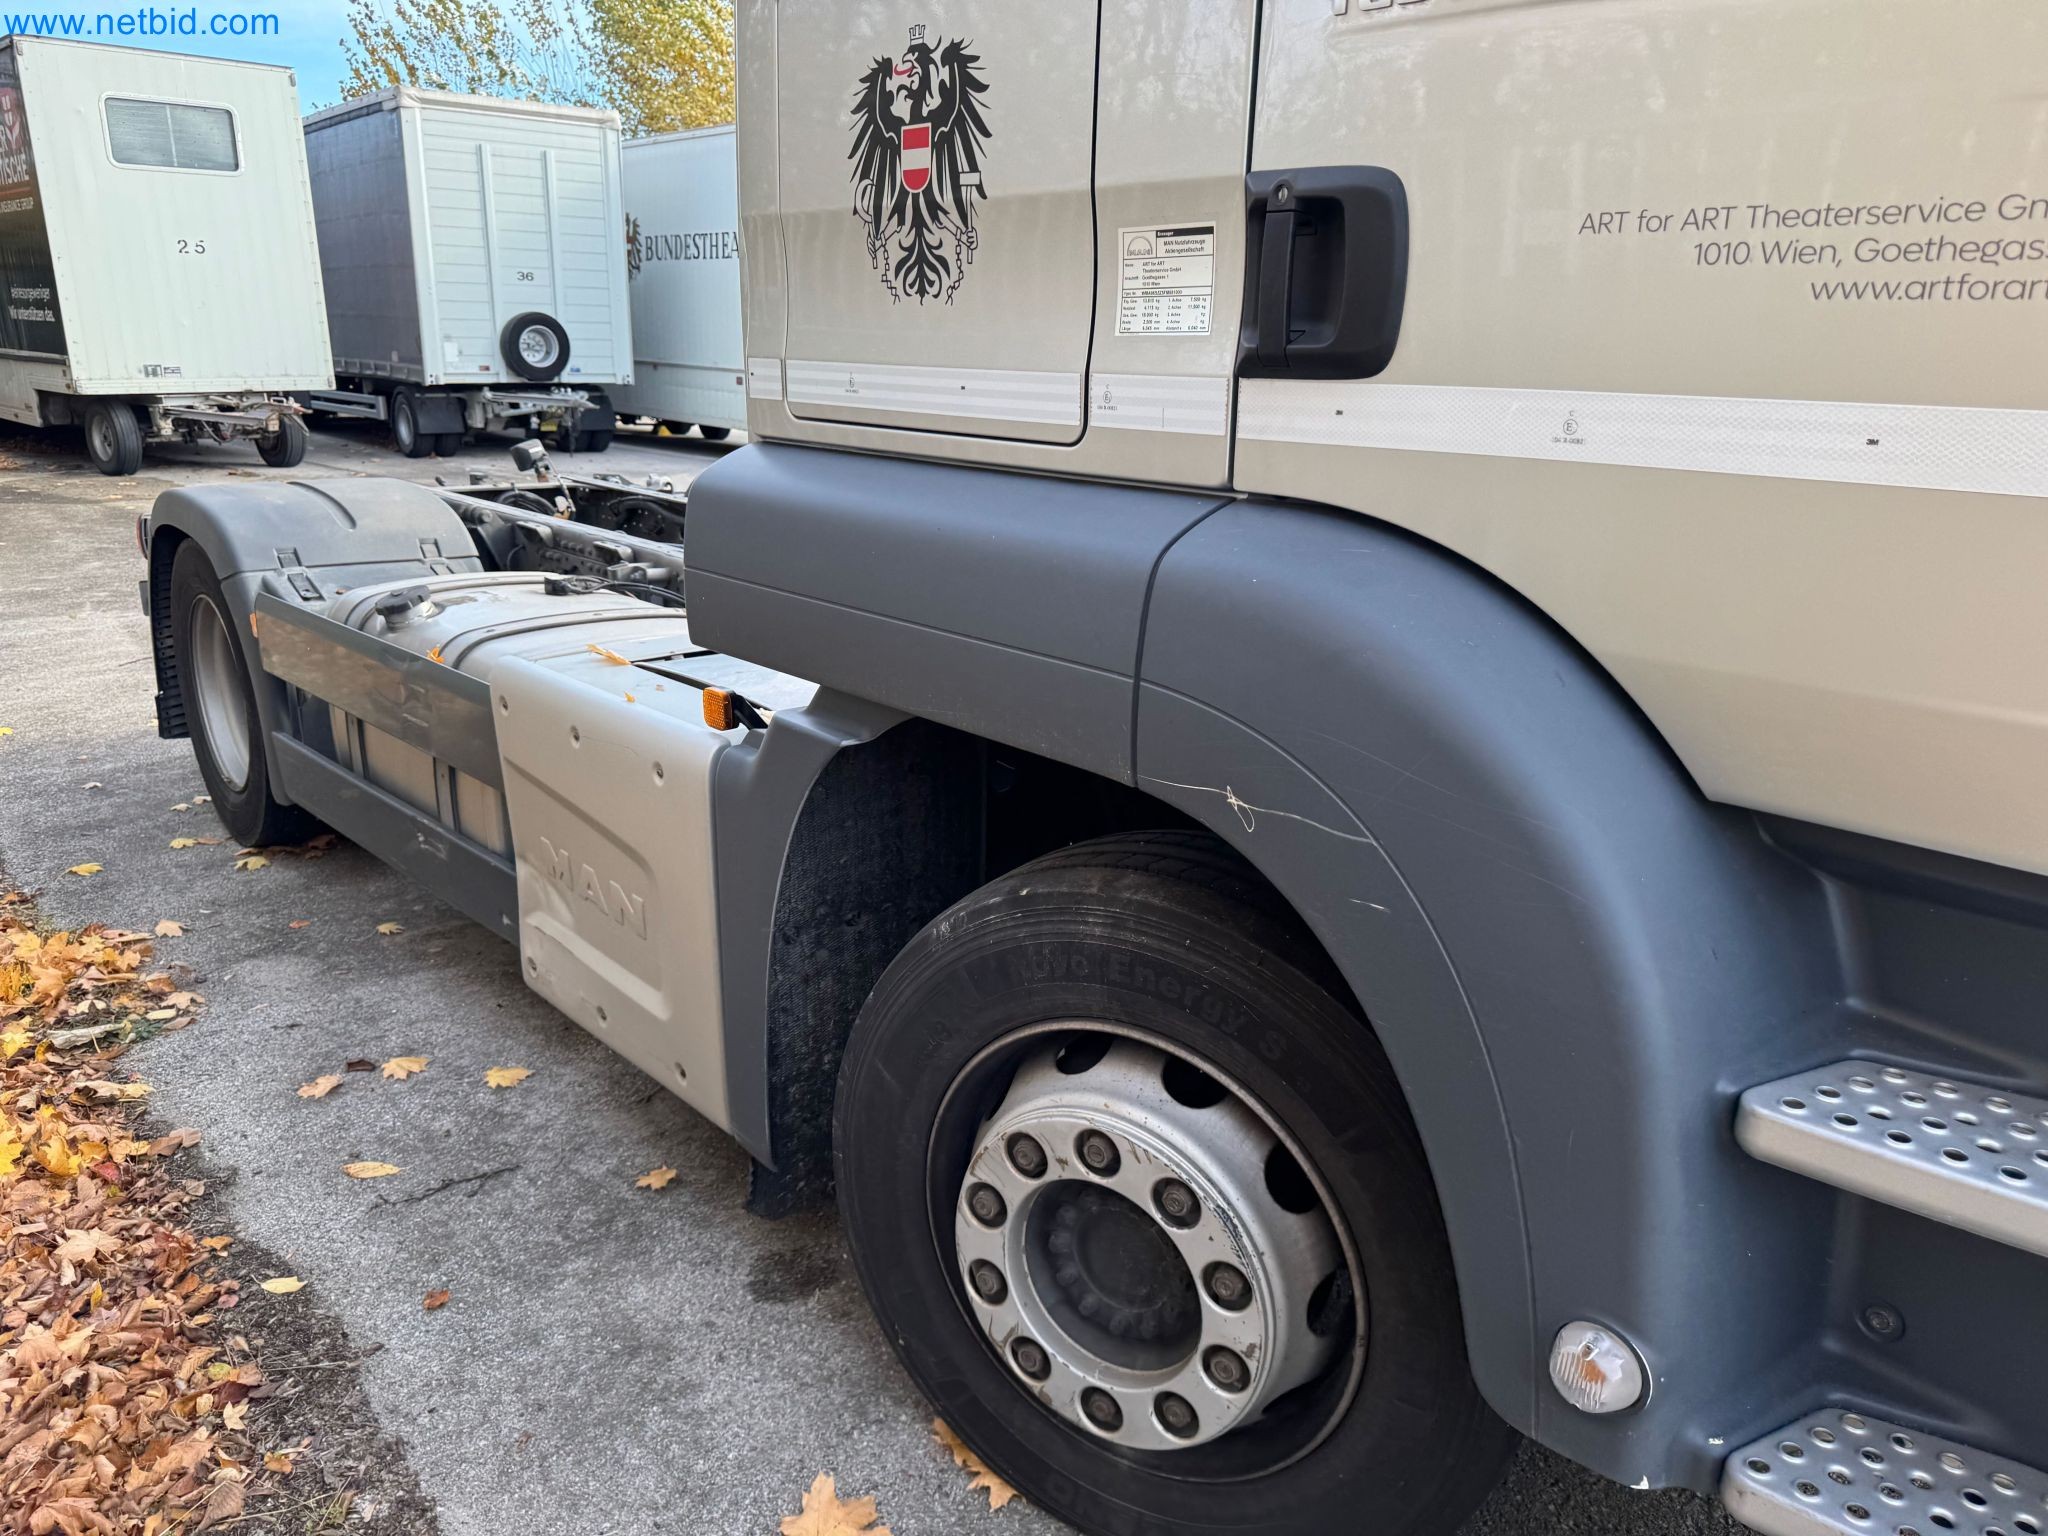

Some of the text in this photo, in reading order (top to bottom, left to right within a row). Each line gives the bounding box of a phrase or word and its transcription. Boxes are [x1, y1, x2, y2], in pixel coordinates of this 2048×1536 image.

[1578, 211, 1631, 235] ART
[1637, 208, 1674, 233] for
[1680, 206, 1738, 231] ART
[1746, 196, 1986, 229] Theaterservice
[1694, 237, 2048, 267] 1010 Wien, Goethegas
[516, 271, 535, 282] 36
[538, 836, 648, 941] MAN
[1109, 951, 1247, 1033] Energy
